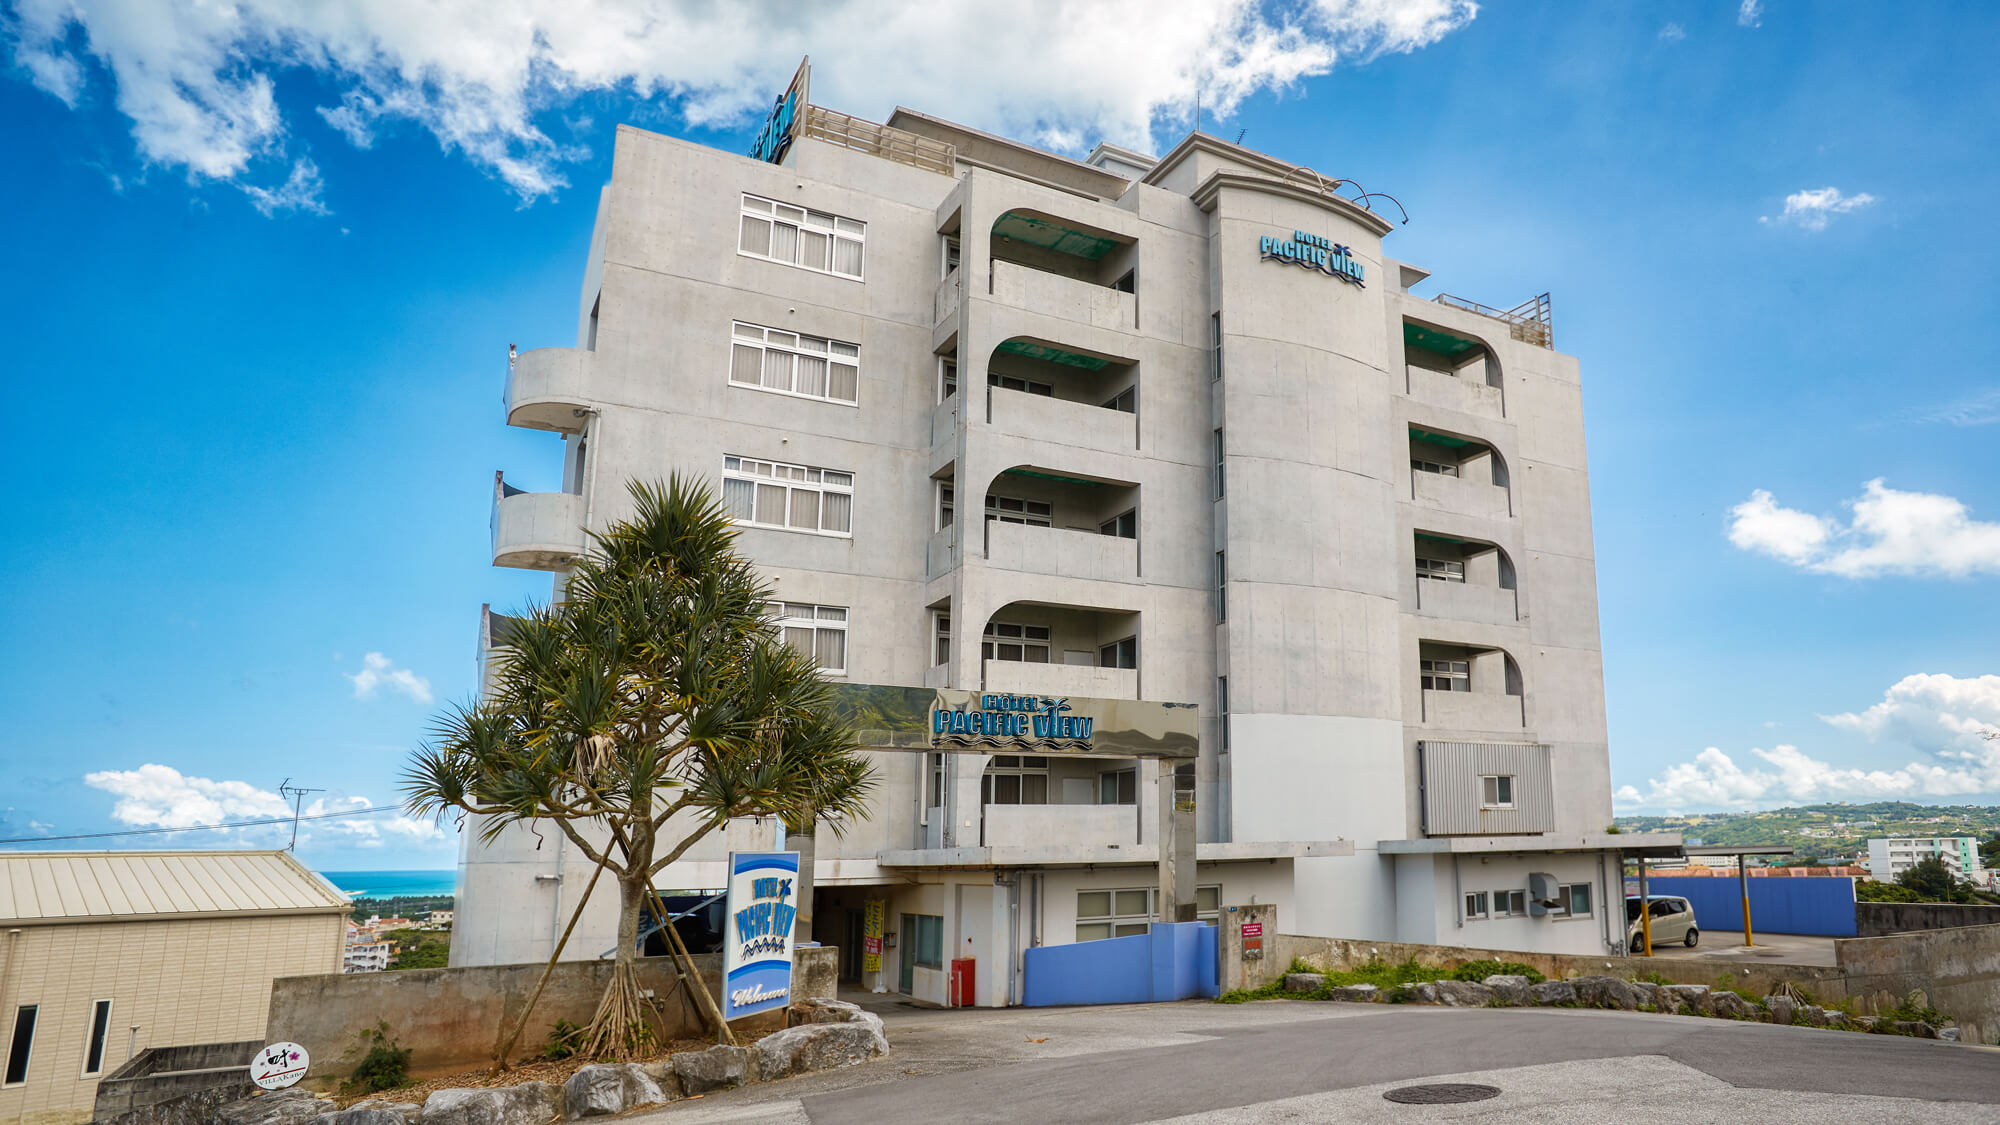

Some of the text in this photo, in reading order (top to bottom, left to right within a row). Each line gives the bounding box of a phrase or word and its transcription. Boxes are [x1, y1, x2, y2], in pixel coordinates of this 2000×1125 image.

[1294, 229, 1333, 251] HOTEL
[1260, 235, 1366, 282] PACIFIC VIEW
[983, 694, 1041, 713] HOTEL
[934, 708, 1094, 739] PACIFIC VIEW
[753, 877, 779, 900] HOTEL
[735, 900, 797, 944] PACIFIC VIEW
[730, 983, 789, 1009] Welcome
